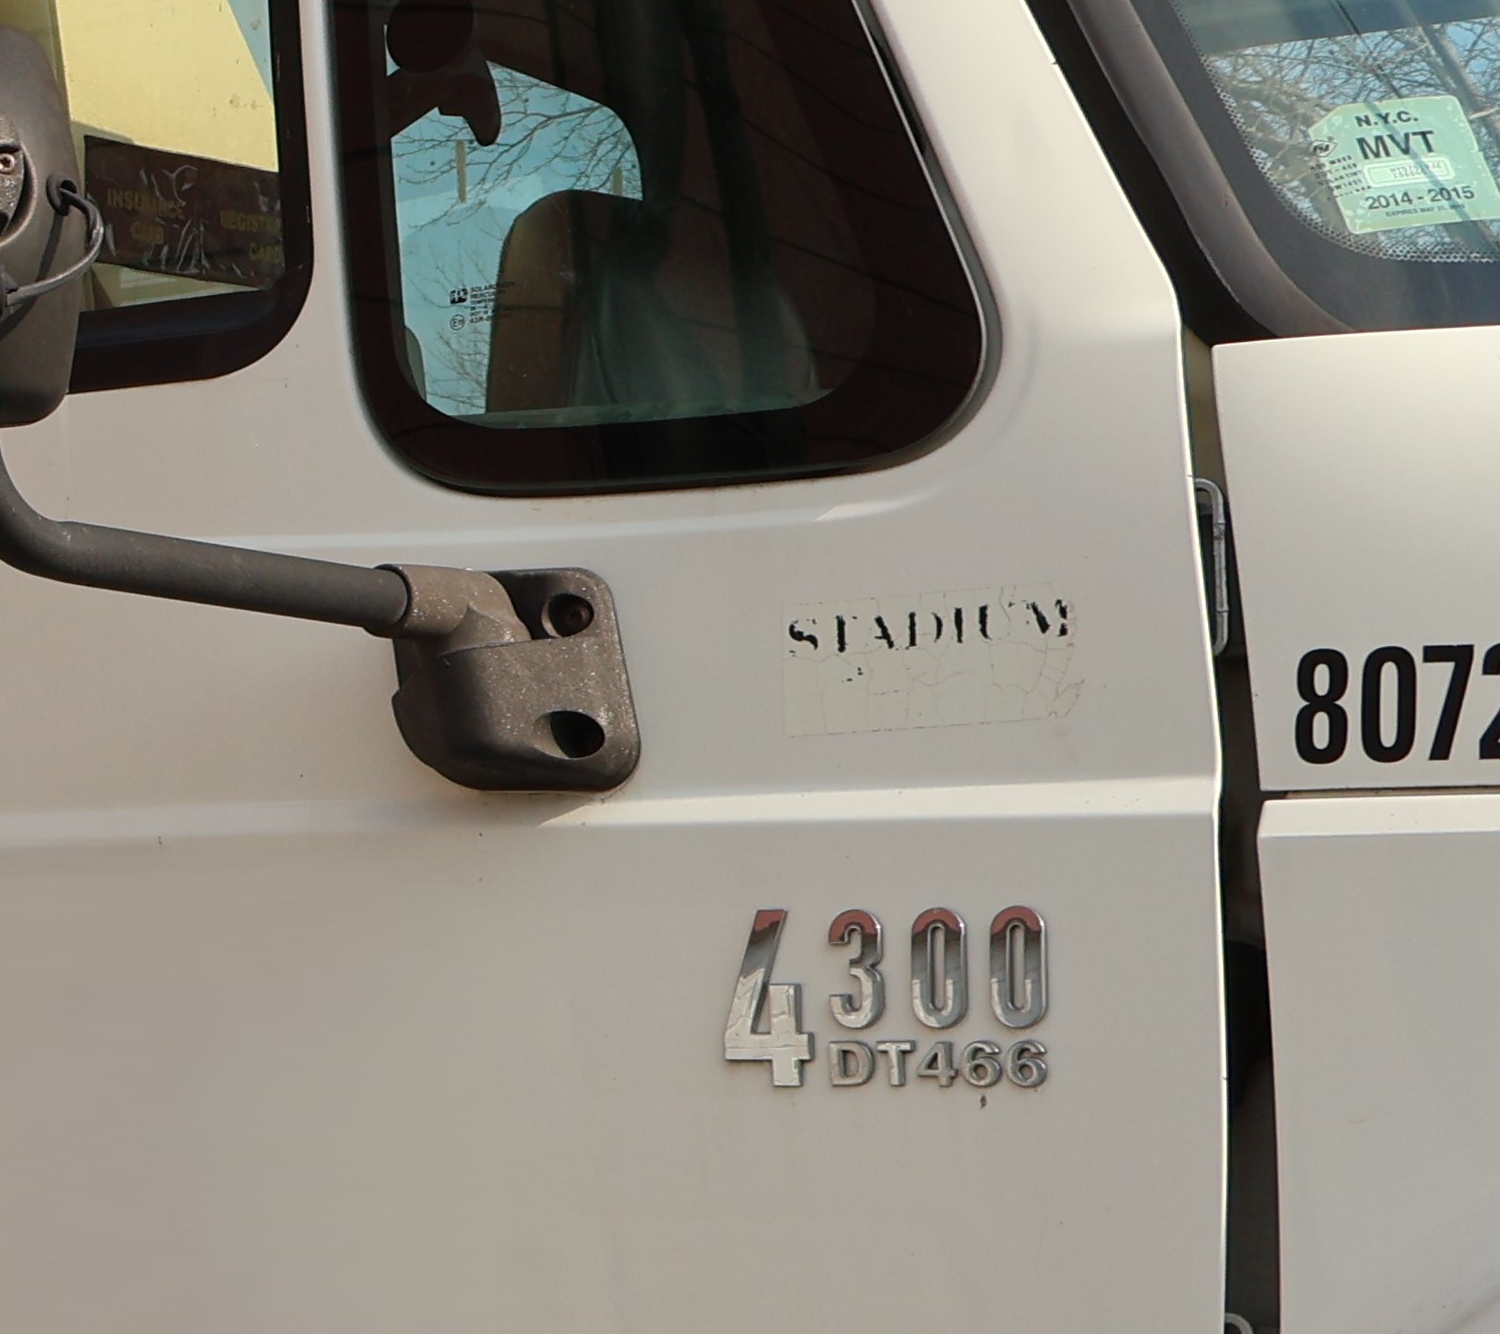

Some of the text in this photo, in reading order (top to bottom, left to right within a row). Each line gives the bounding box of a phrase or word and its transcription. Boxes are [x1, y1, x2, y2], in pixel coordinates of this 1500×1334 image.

[1355, 110, 1419, 128] N.Y.C.
[1356, 129, 1435, 160] MVT
[1365, 191, 1413, 210] 2014
[1427, 185, 1475, 203] 2015
[723, 903, 1051, 1089] 4300
[828, 1038, 1050, 1090] DT466
